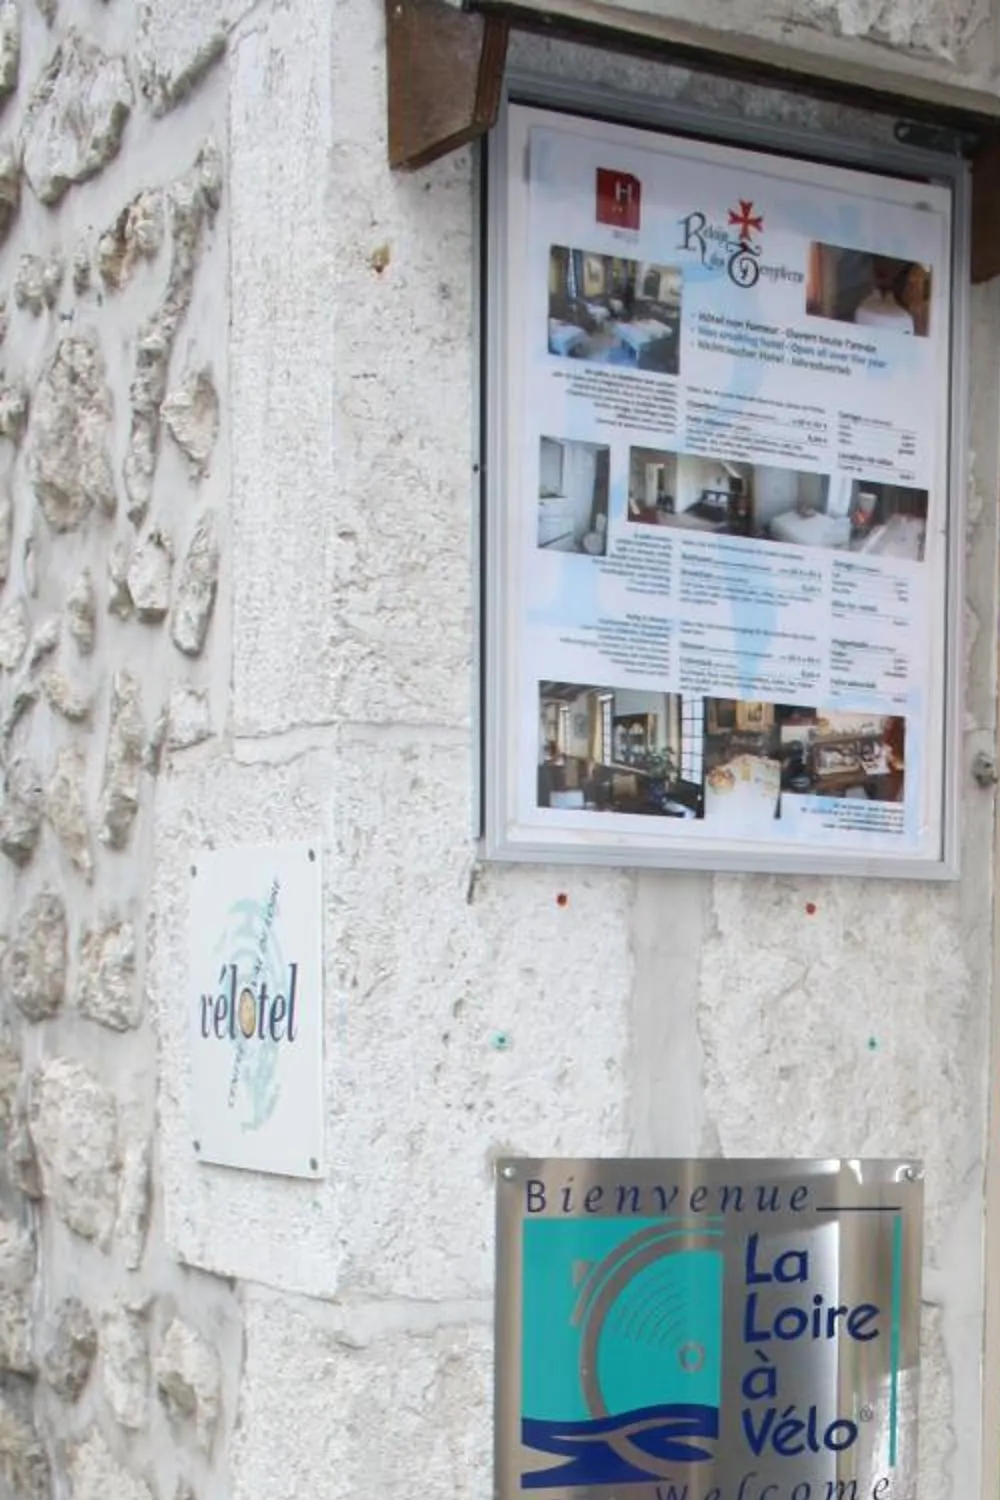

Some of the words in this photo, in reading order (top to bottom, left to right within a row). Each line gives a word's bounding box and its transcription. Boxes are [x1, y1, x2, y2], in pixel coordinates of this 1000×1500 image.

[525, 1177, 810, 1214] Bienvenue
[744, 1232, 809, 1285] La
[742, 1292, 881, 1344] Loire
[740, 1349, 777, 1400] à
